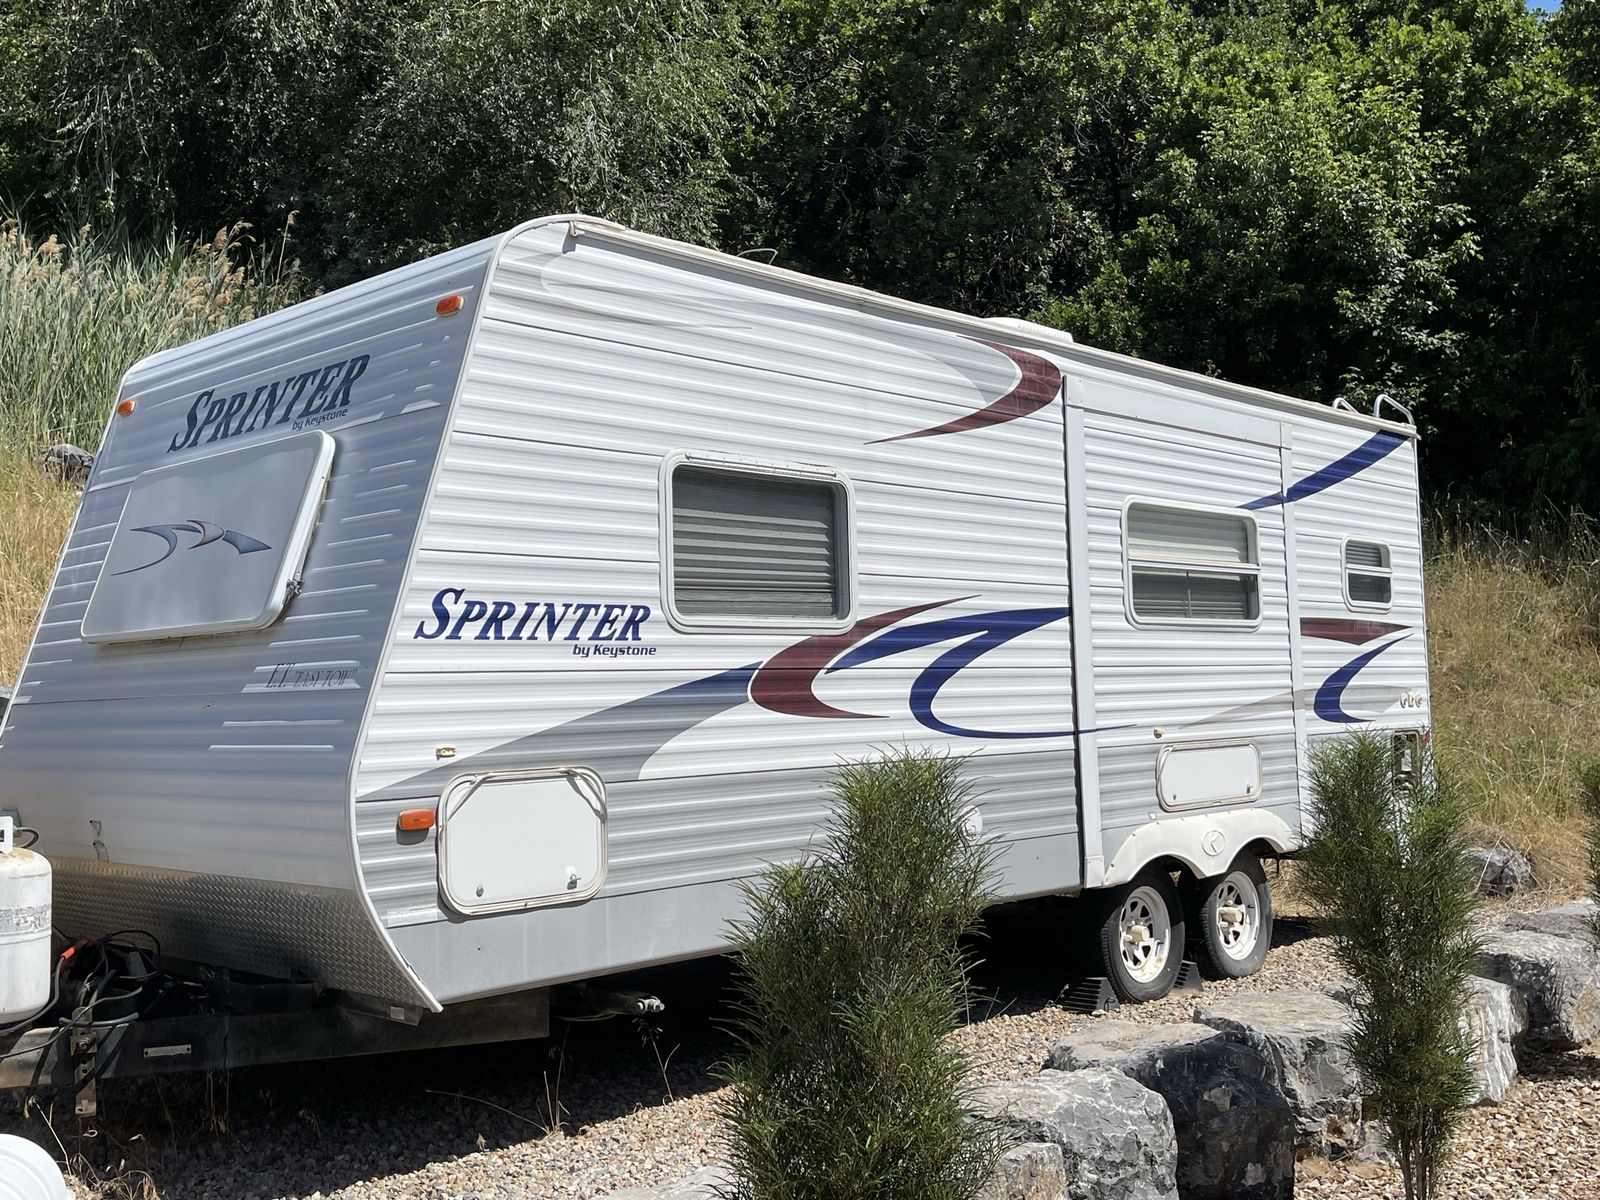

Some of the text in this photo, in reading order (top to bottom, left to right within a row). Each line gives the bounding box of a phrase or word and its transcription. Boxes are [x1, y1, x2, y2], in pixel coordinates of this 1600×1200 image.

[167, 354, 371, 453] SPRINTER
[292, 408, 348, 431] by Keystone
[413, 587, 651, 642] SPRINTER
[572, 644, 657, 658] by Keystone
